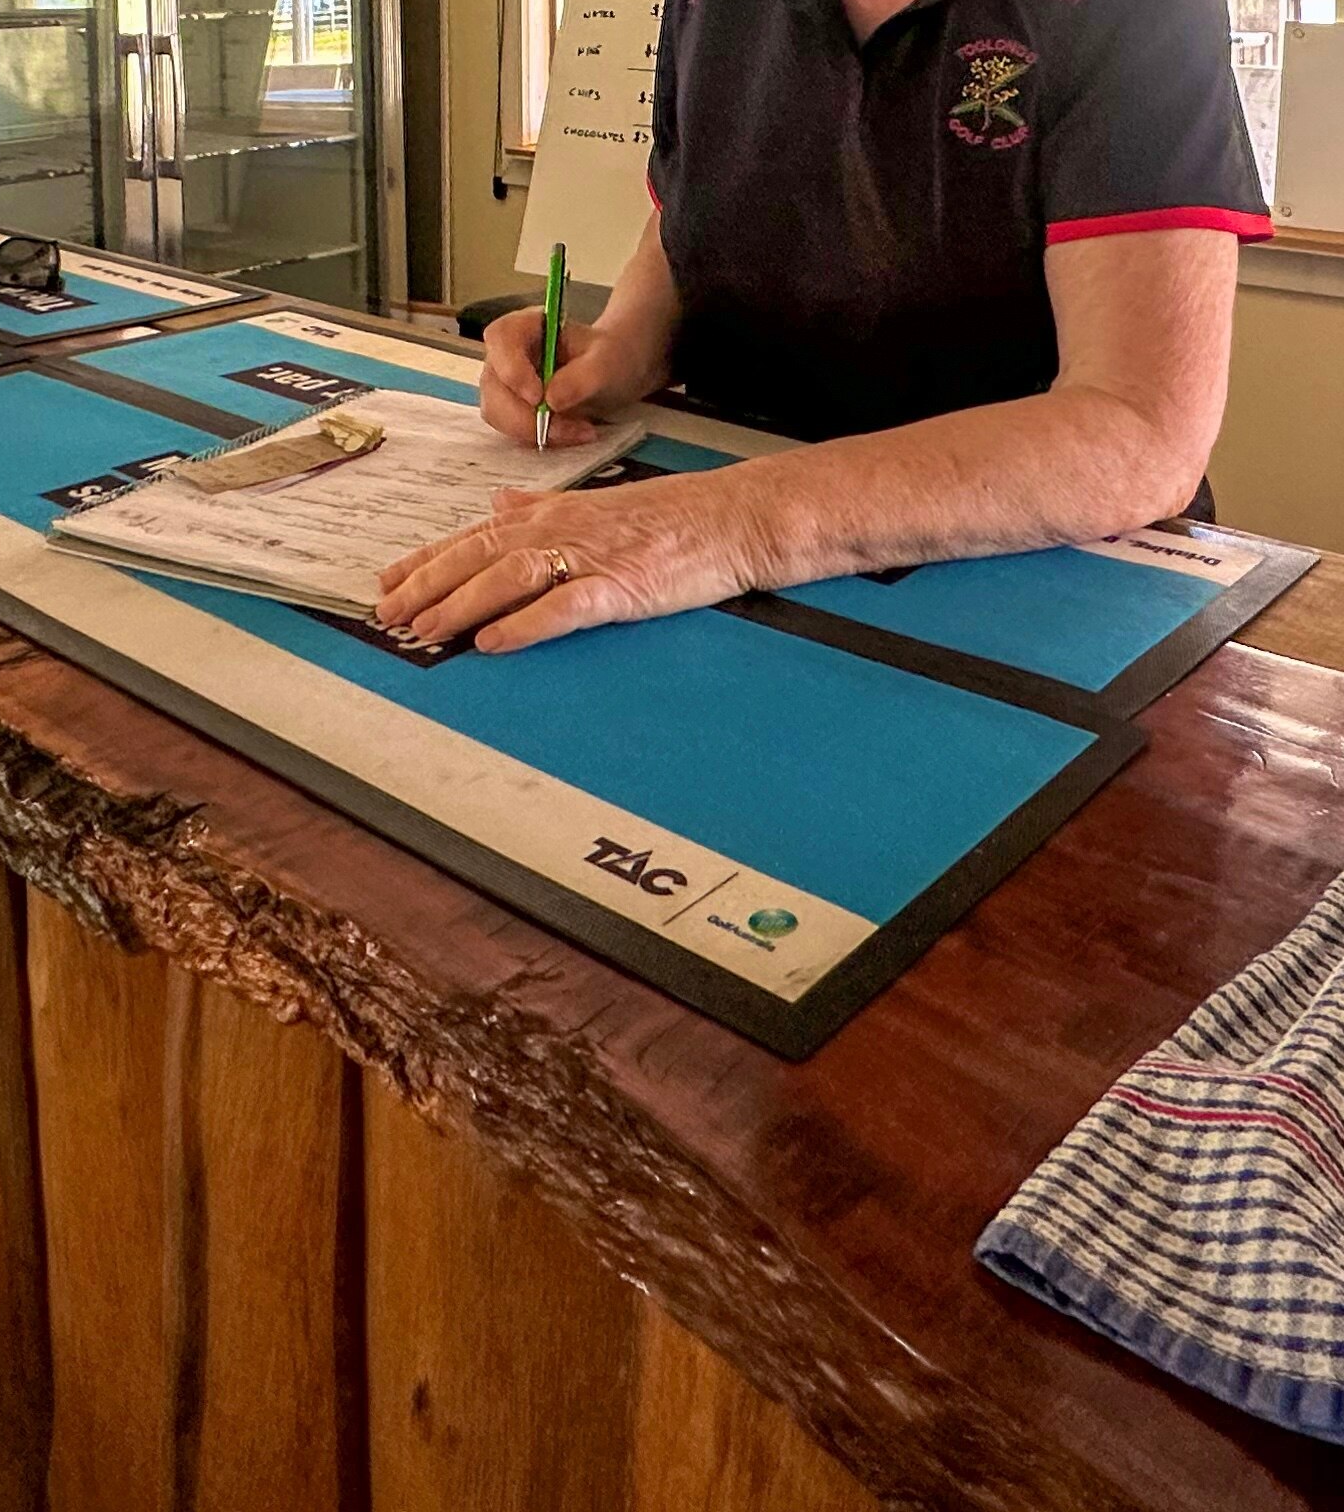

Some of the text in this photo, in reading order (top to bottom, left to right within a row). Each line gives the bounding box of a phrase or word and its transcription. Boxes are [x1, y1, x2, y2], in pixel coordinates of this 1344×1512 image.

[569, 87, 601, 100] CHIPS
[563, 126, 625, 143] CHOCOLATES
[584, 836, 688, 896] TAC
